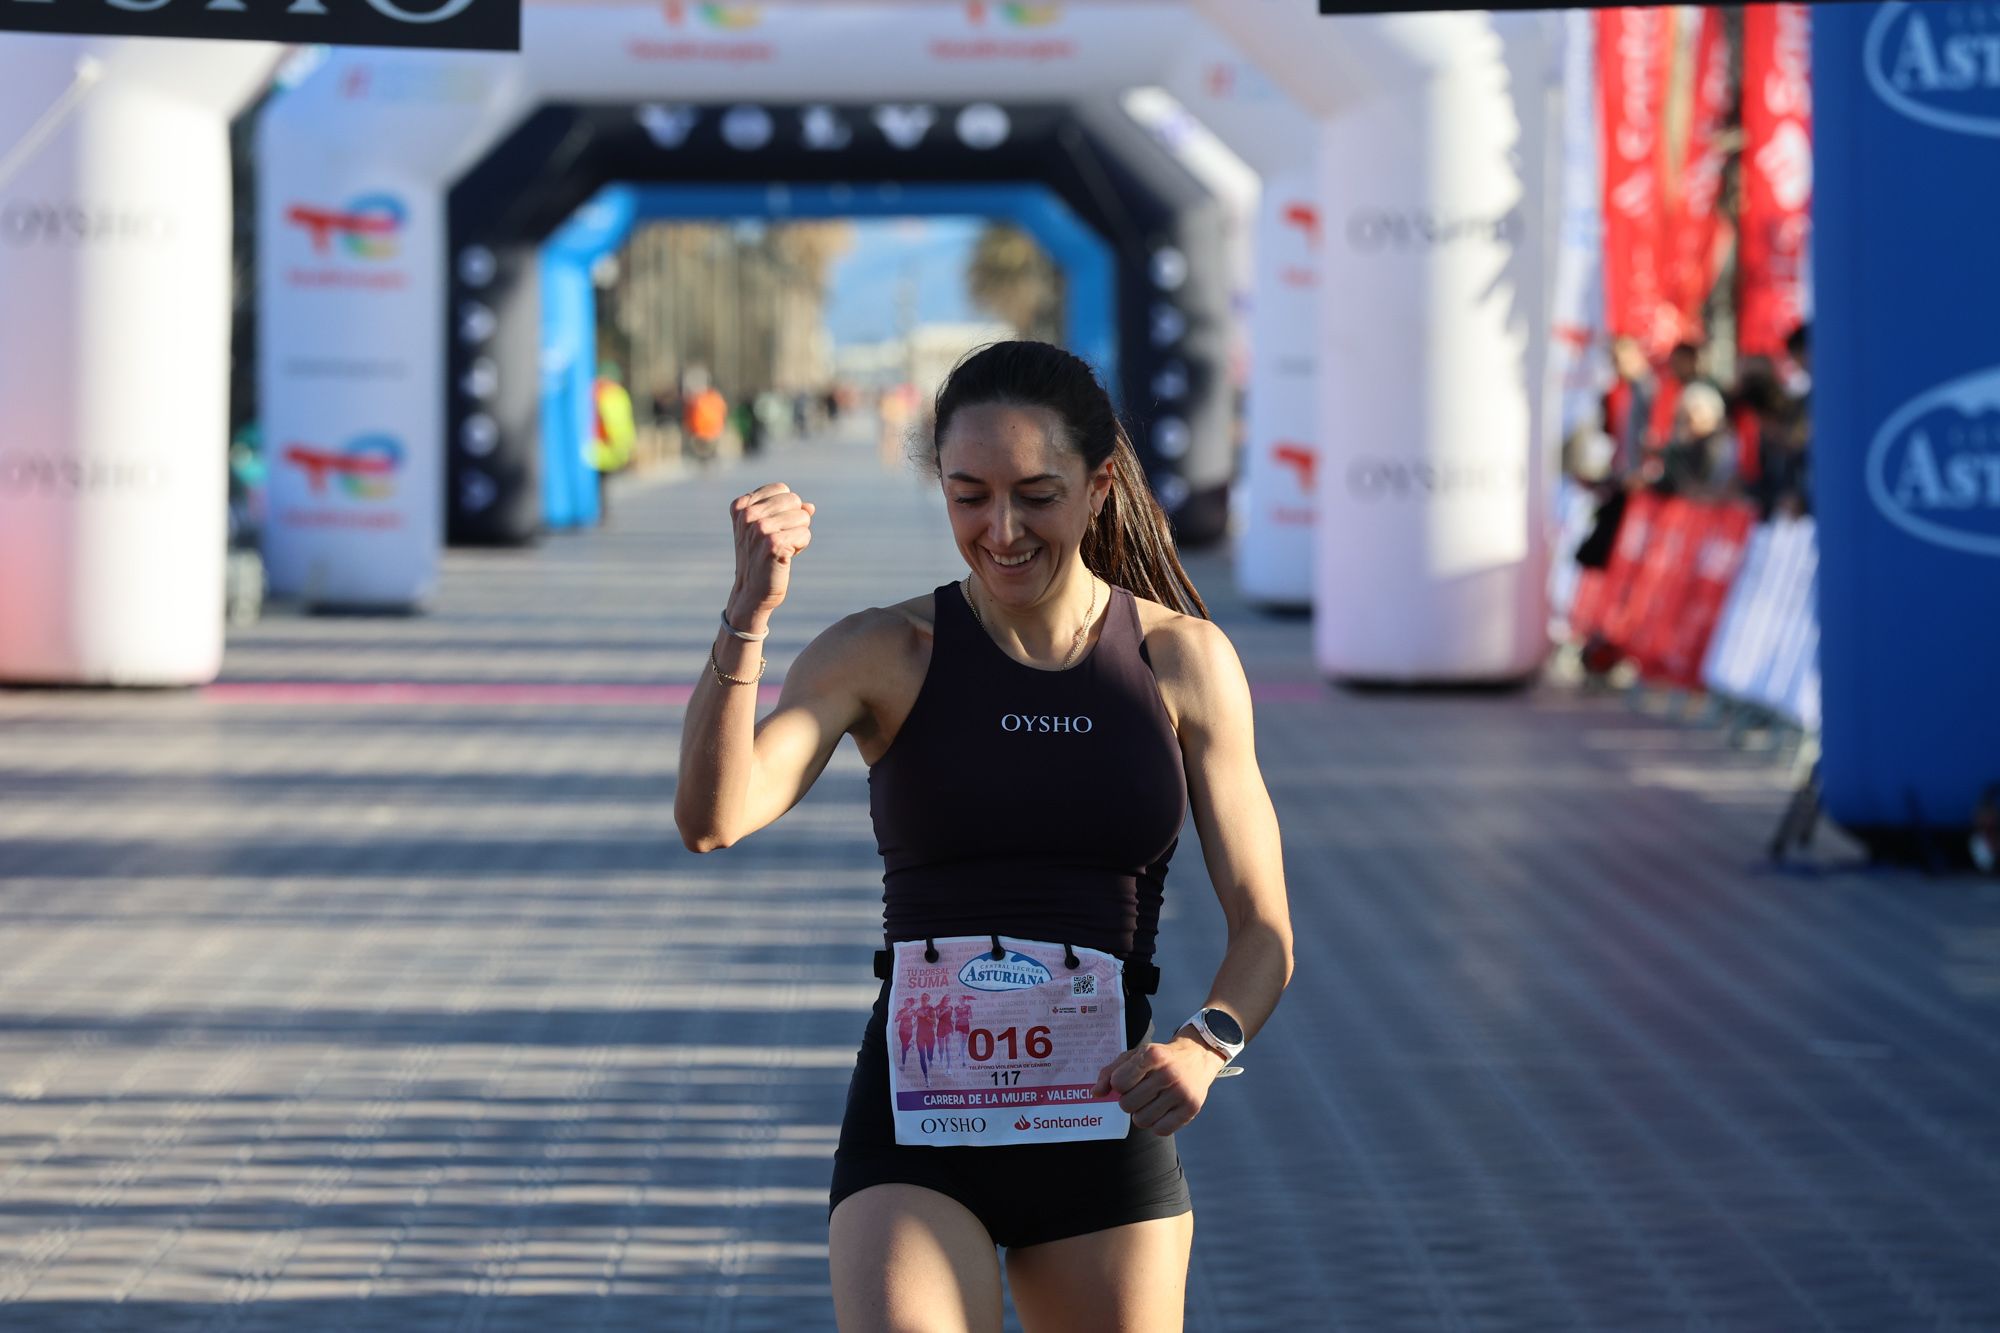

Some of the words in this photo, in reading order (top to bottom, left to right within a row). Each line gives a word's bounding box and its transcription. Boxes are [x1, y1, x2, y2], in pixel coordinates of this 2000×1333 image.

[635, 103, 1011, 150] VOLVO
[1001, 713, 1093, 733] OYSHO
[908, 975, 949, 989] SUMA
[964, 966, 1045, 985] ASTURIANA
[967, 1025, 1053, 1062] 016
[991, 1070, 1021, 1086] 117
[923, 1094, 966, 1106] CARRERA
[968, 1093, 982, 1105] DE
[985, 1093, 999, 1104] LA
[1001, 1091, 1038, 1103] MUJER
[1046, 1089, 1093, 1101] VALENCI
[921, 1117, 987, 1134] OYSHO
[1033, 1115, 1103, 1130] Santander
